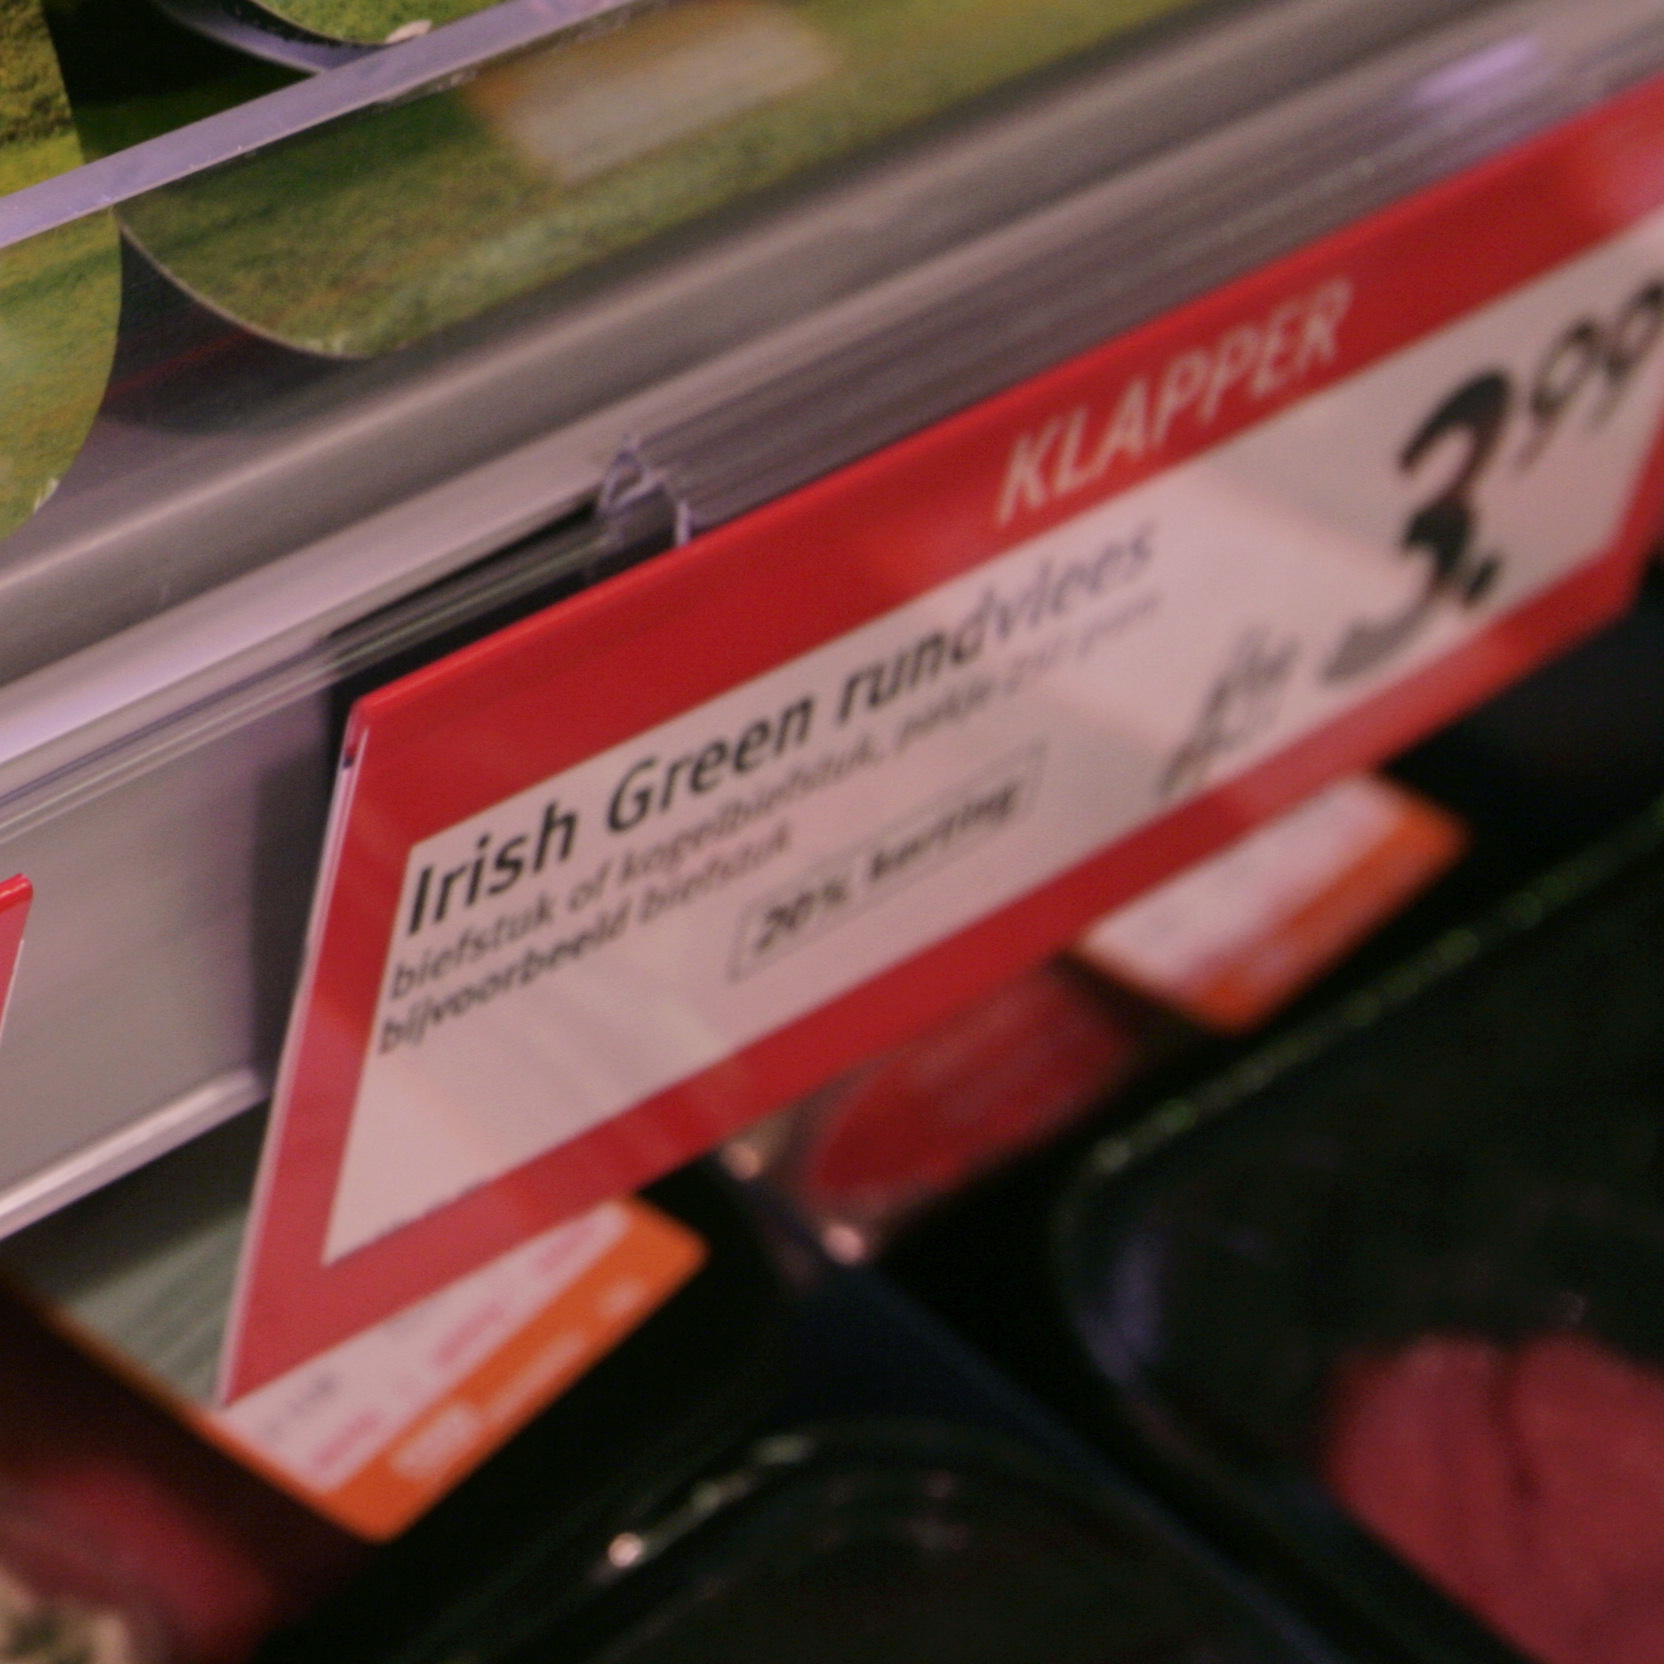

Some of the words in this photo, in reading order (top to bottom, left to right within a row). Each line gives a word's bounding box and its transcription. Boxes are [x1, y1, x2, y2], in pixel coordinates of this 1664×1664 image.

[995, 275, 1356, 526] KLAPPER
[407, 799, 578, 938] Irish
[605, 694, 814, 836] Green
[836, 521, 1156, 727] rundvlees
